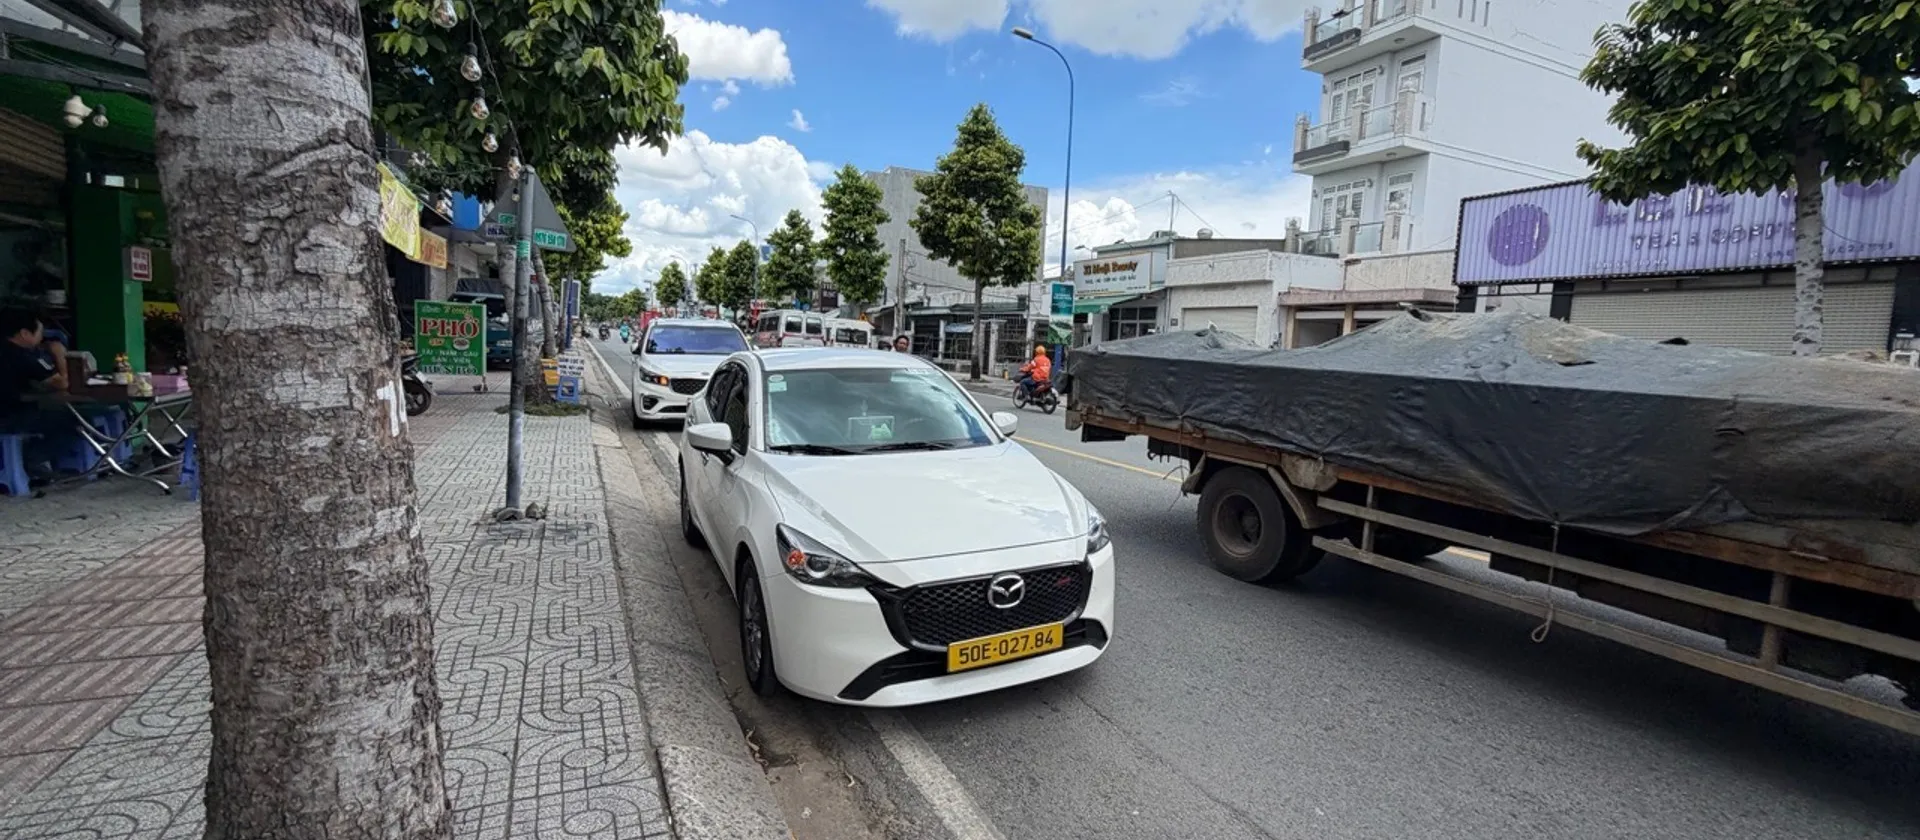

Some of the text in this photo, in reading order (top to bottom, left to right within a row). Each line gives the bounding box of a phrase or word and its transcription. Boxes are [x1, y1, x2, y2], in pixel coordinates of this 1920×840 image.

[1631, 232, 1680, 250] TEA
[1711, 220, 1797, 245] COFF
[419, 313, 480, 339] PHỞ
[959, 629, 1053, 665] 50E-027.84
